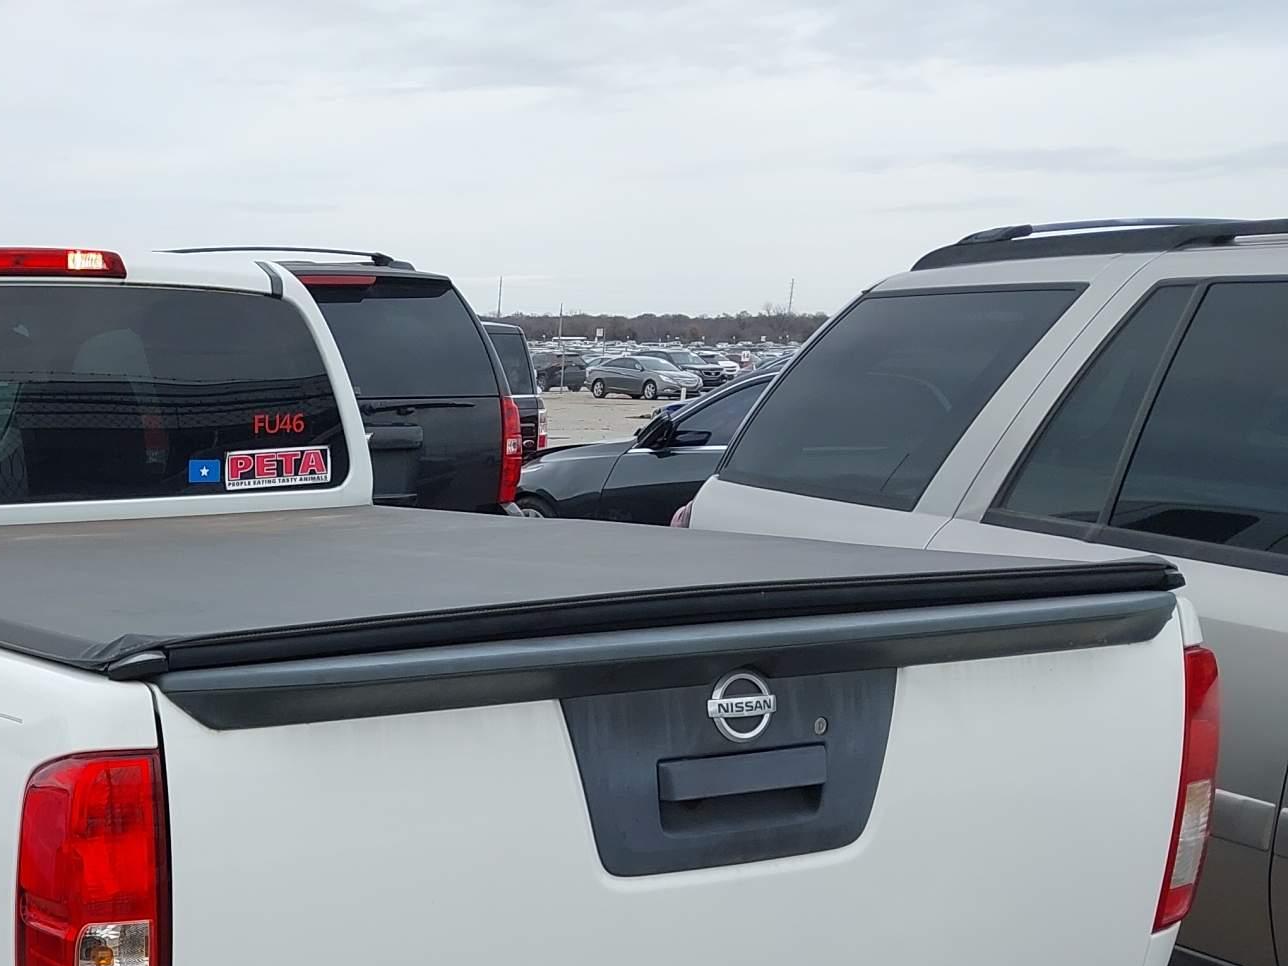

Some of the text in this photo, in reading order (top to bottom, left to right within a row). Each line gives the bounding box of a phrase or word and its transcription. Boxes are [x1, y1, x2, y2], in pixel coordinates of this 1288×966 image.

[254, 413, 305, 434] FU46
[228, 450, 327, 480] PETA
[717, 698, 772, 713] NISSAN
